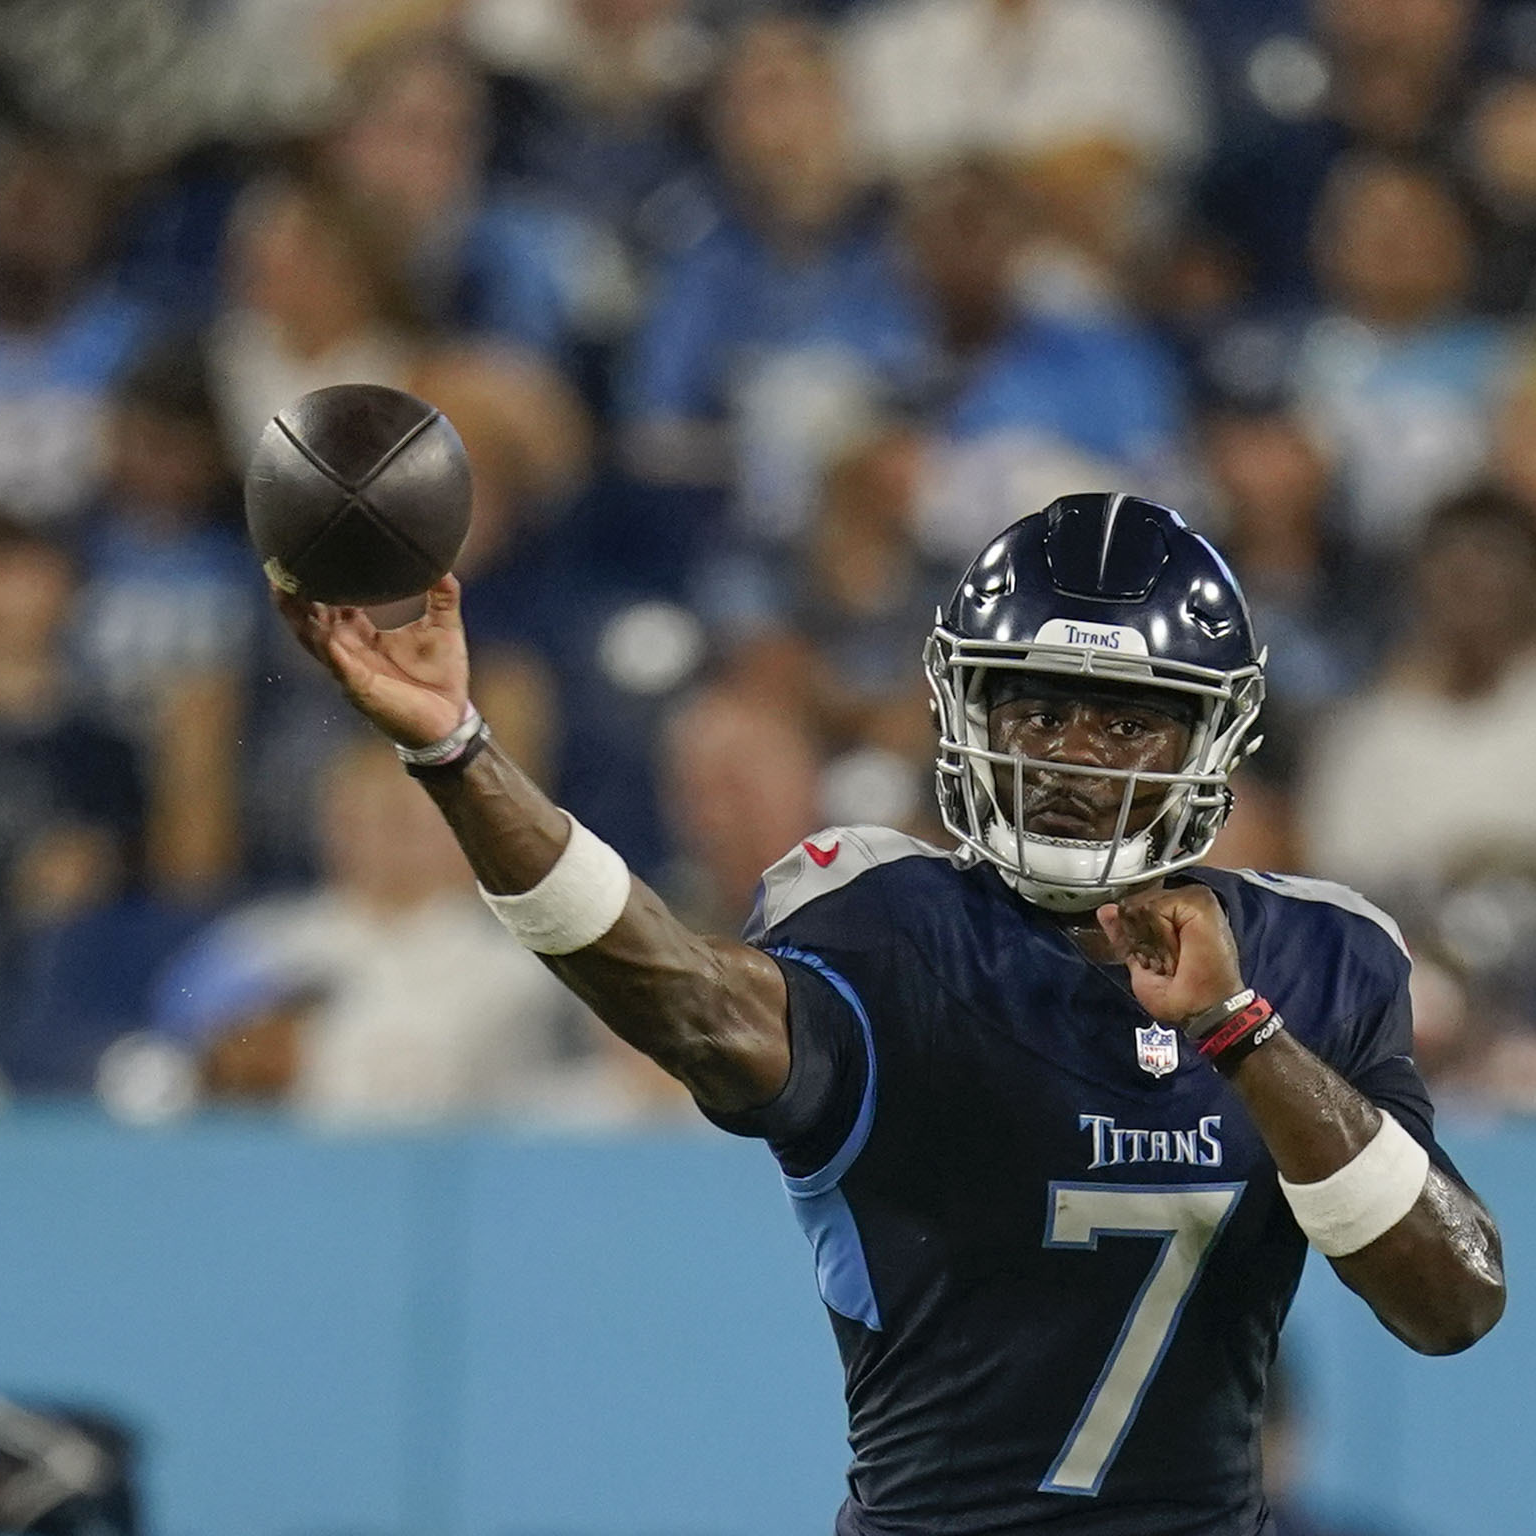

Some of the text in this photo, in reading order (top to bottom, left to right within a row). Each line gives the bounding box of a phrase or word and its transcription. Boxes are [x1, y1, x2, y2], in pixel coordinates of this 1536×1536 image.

[1064, 624, 1121, 649] TITANS
[1078, 1113, 1223, 1171] TITANS
[1037, 1180, 1249, 1498] 7
